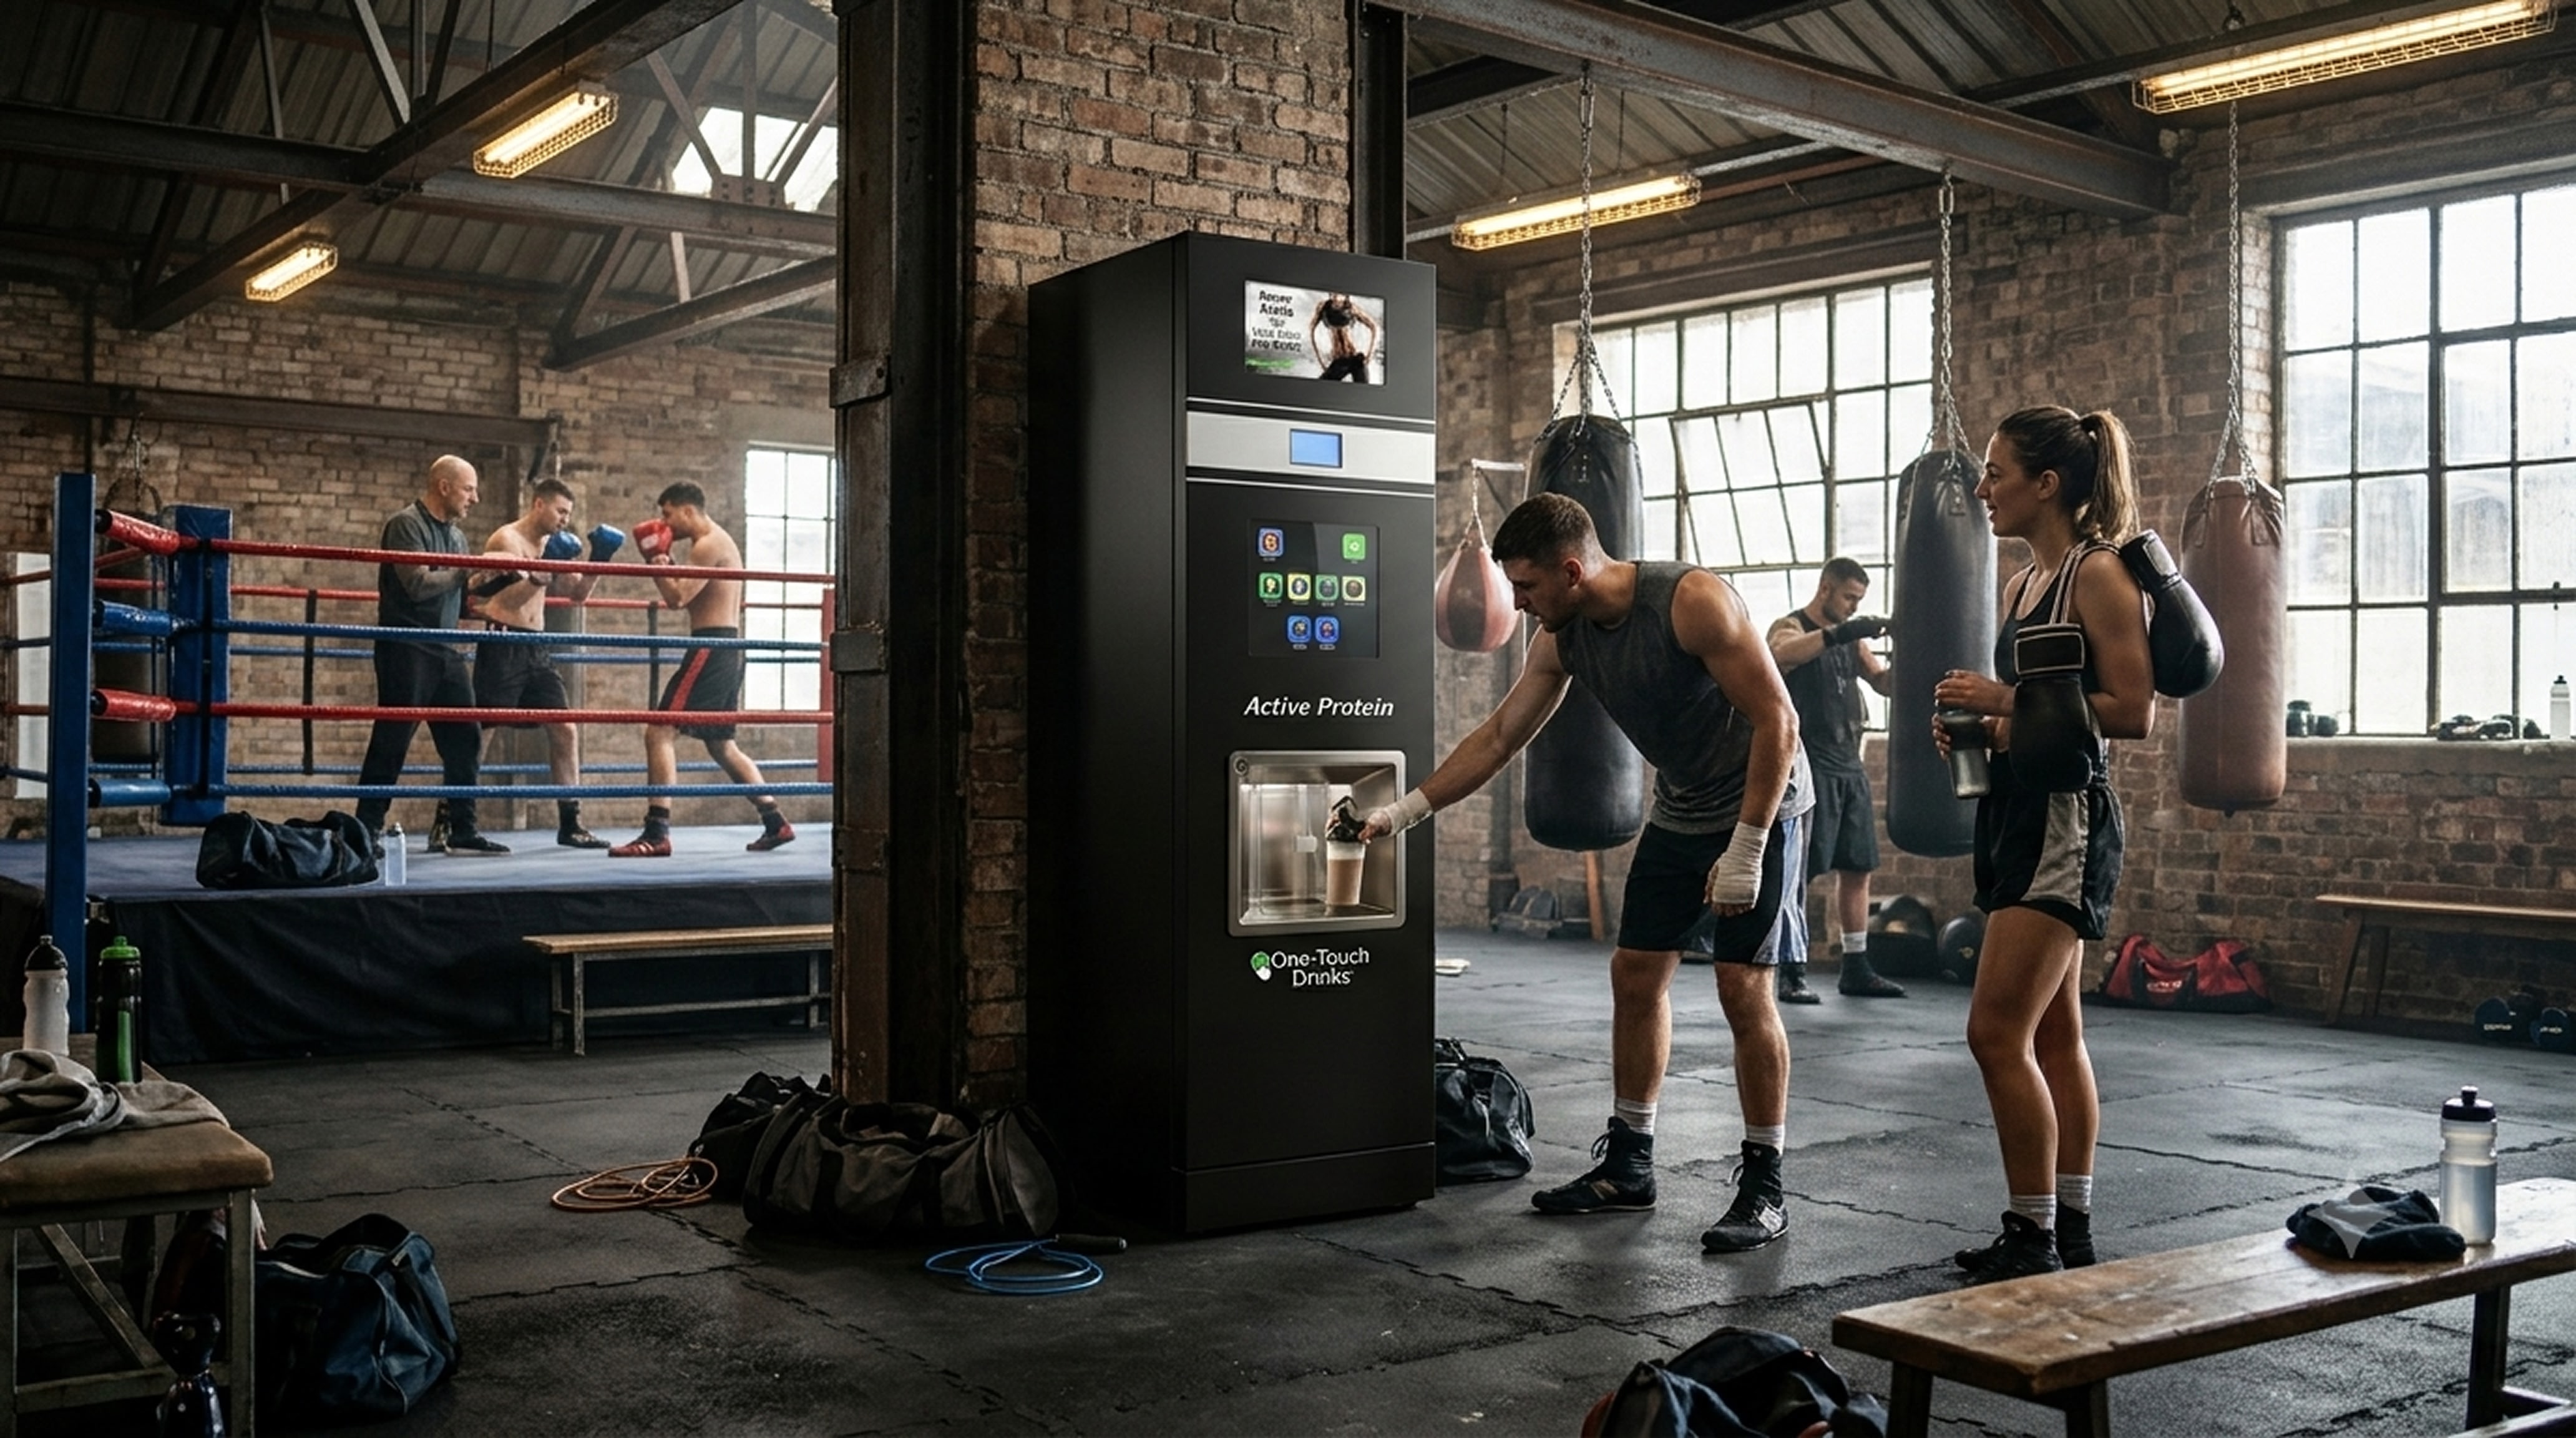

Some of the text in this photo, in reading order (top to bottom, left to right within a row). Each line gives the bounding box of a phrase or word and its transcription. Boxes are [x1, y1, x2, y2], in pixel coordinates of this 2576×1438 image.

[1244, 696, 1394, 716] Active Protein
[1271, 947, 1370, 968] One-Touch
